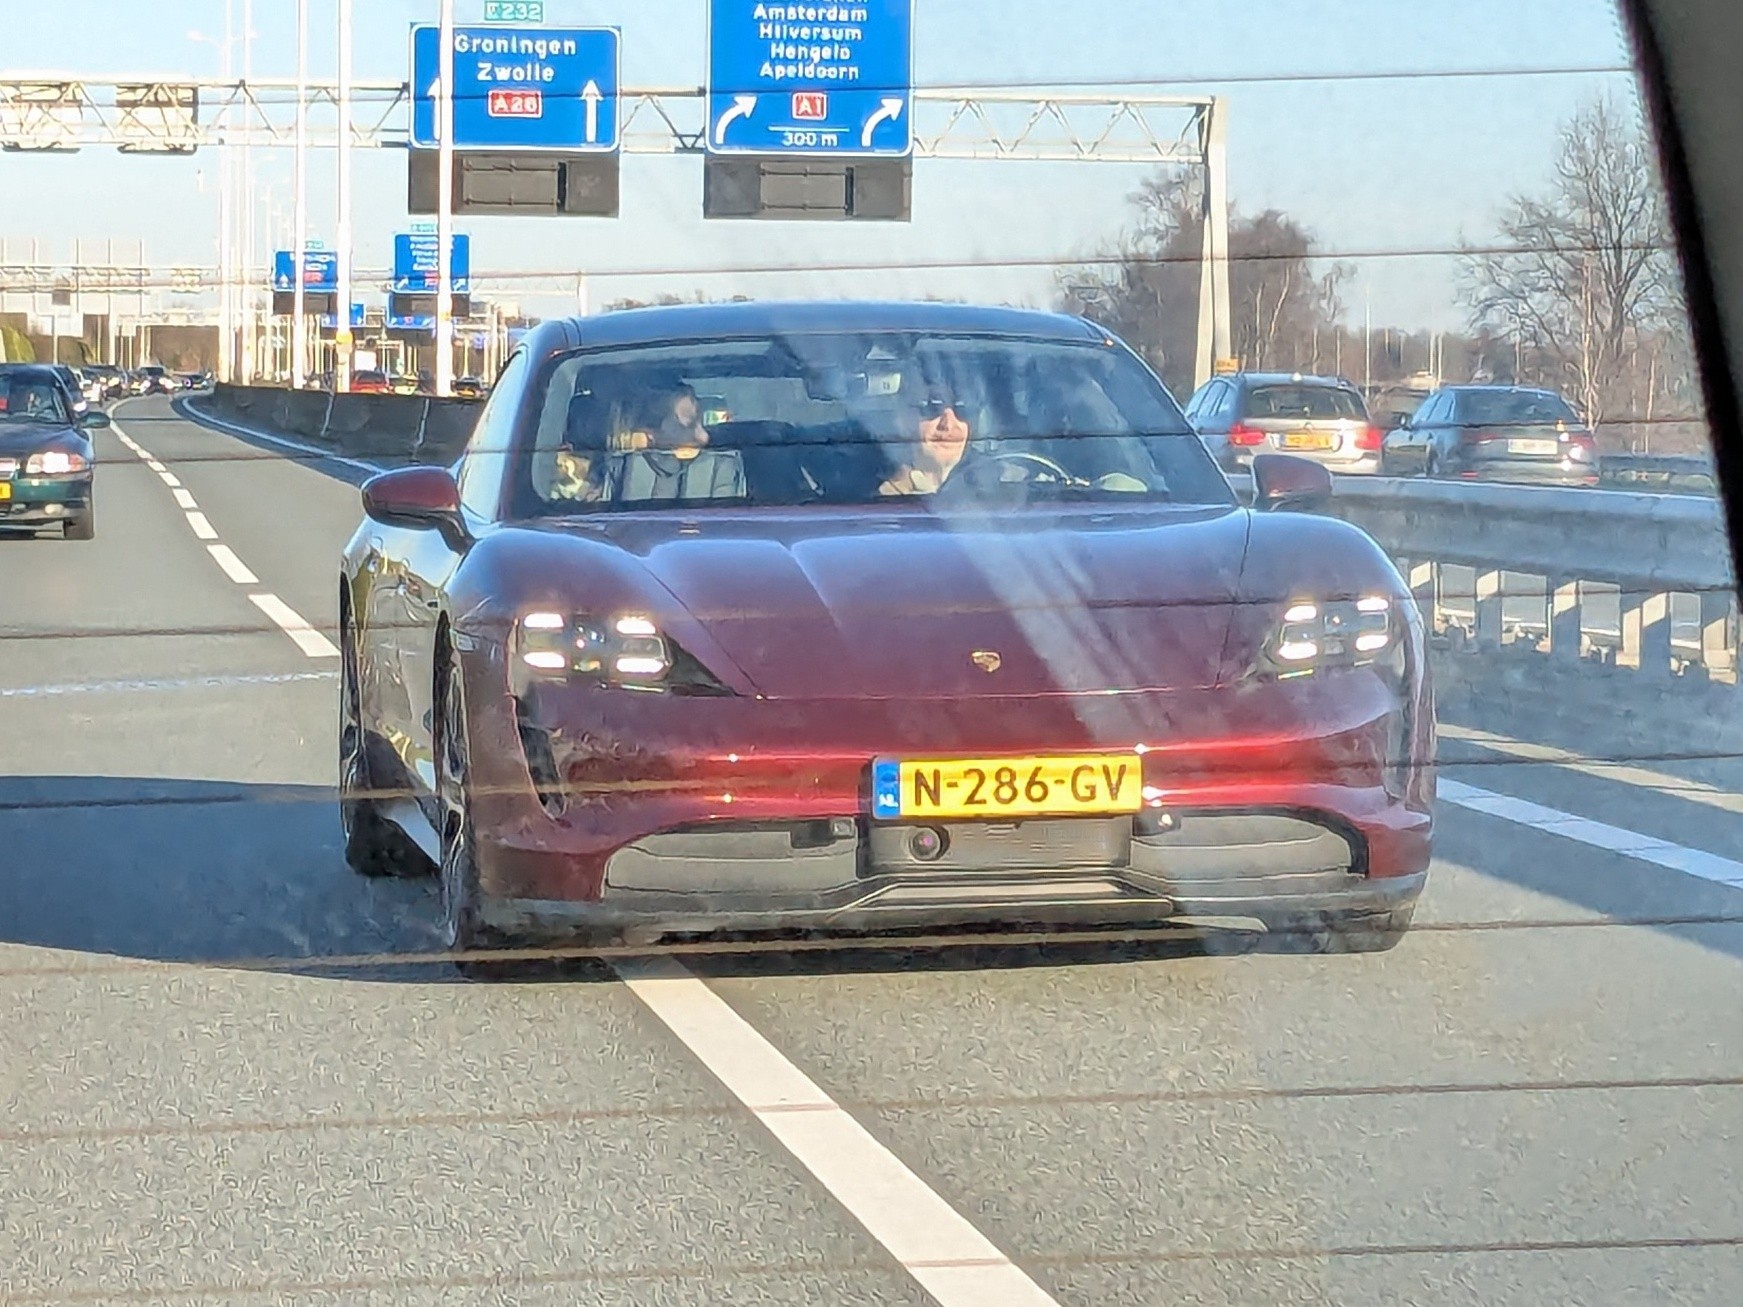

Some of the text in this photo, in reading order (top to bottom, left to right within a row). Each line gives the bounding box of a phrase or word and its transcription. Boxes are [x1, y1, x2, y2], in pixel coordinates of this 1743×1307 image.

[753, 4, 868, 22] Amsterdam
[759, 23, 862, 41] Hilversum
[454, 34, 576, 60] Groningen
[770, 42, 851, 63] Hengelo
[477, 62, 555, 82] Zwolle
[759, 62, 859, 81] Apeldoorn
[799, 95, 822, 116] A1
[783, 132, 838, 147] 300 m
[914, 763, 1127, 807] N-286-GV
